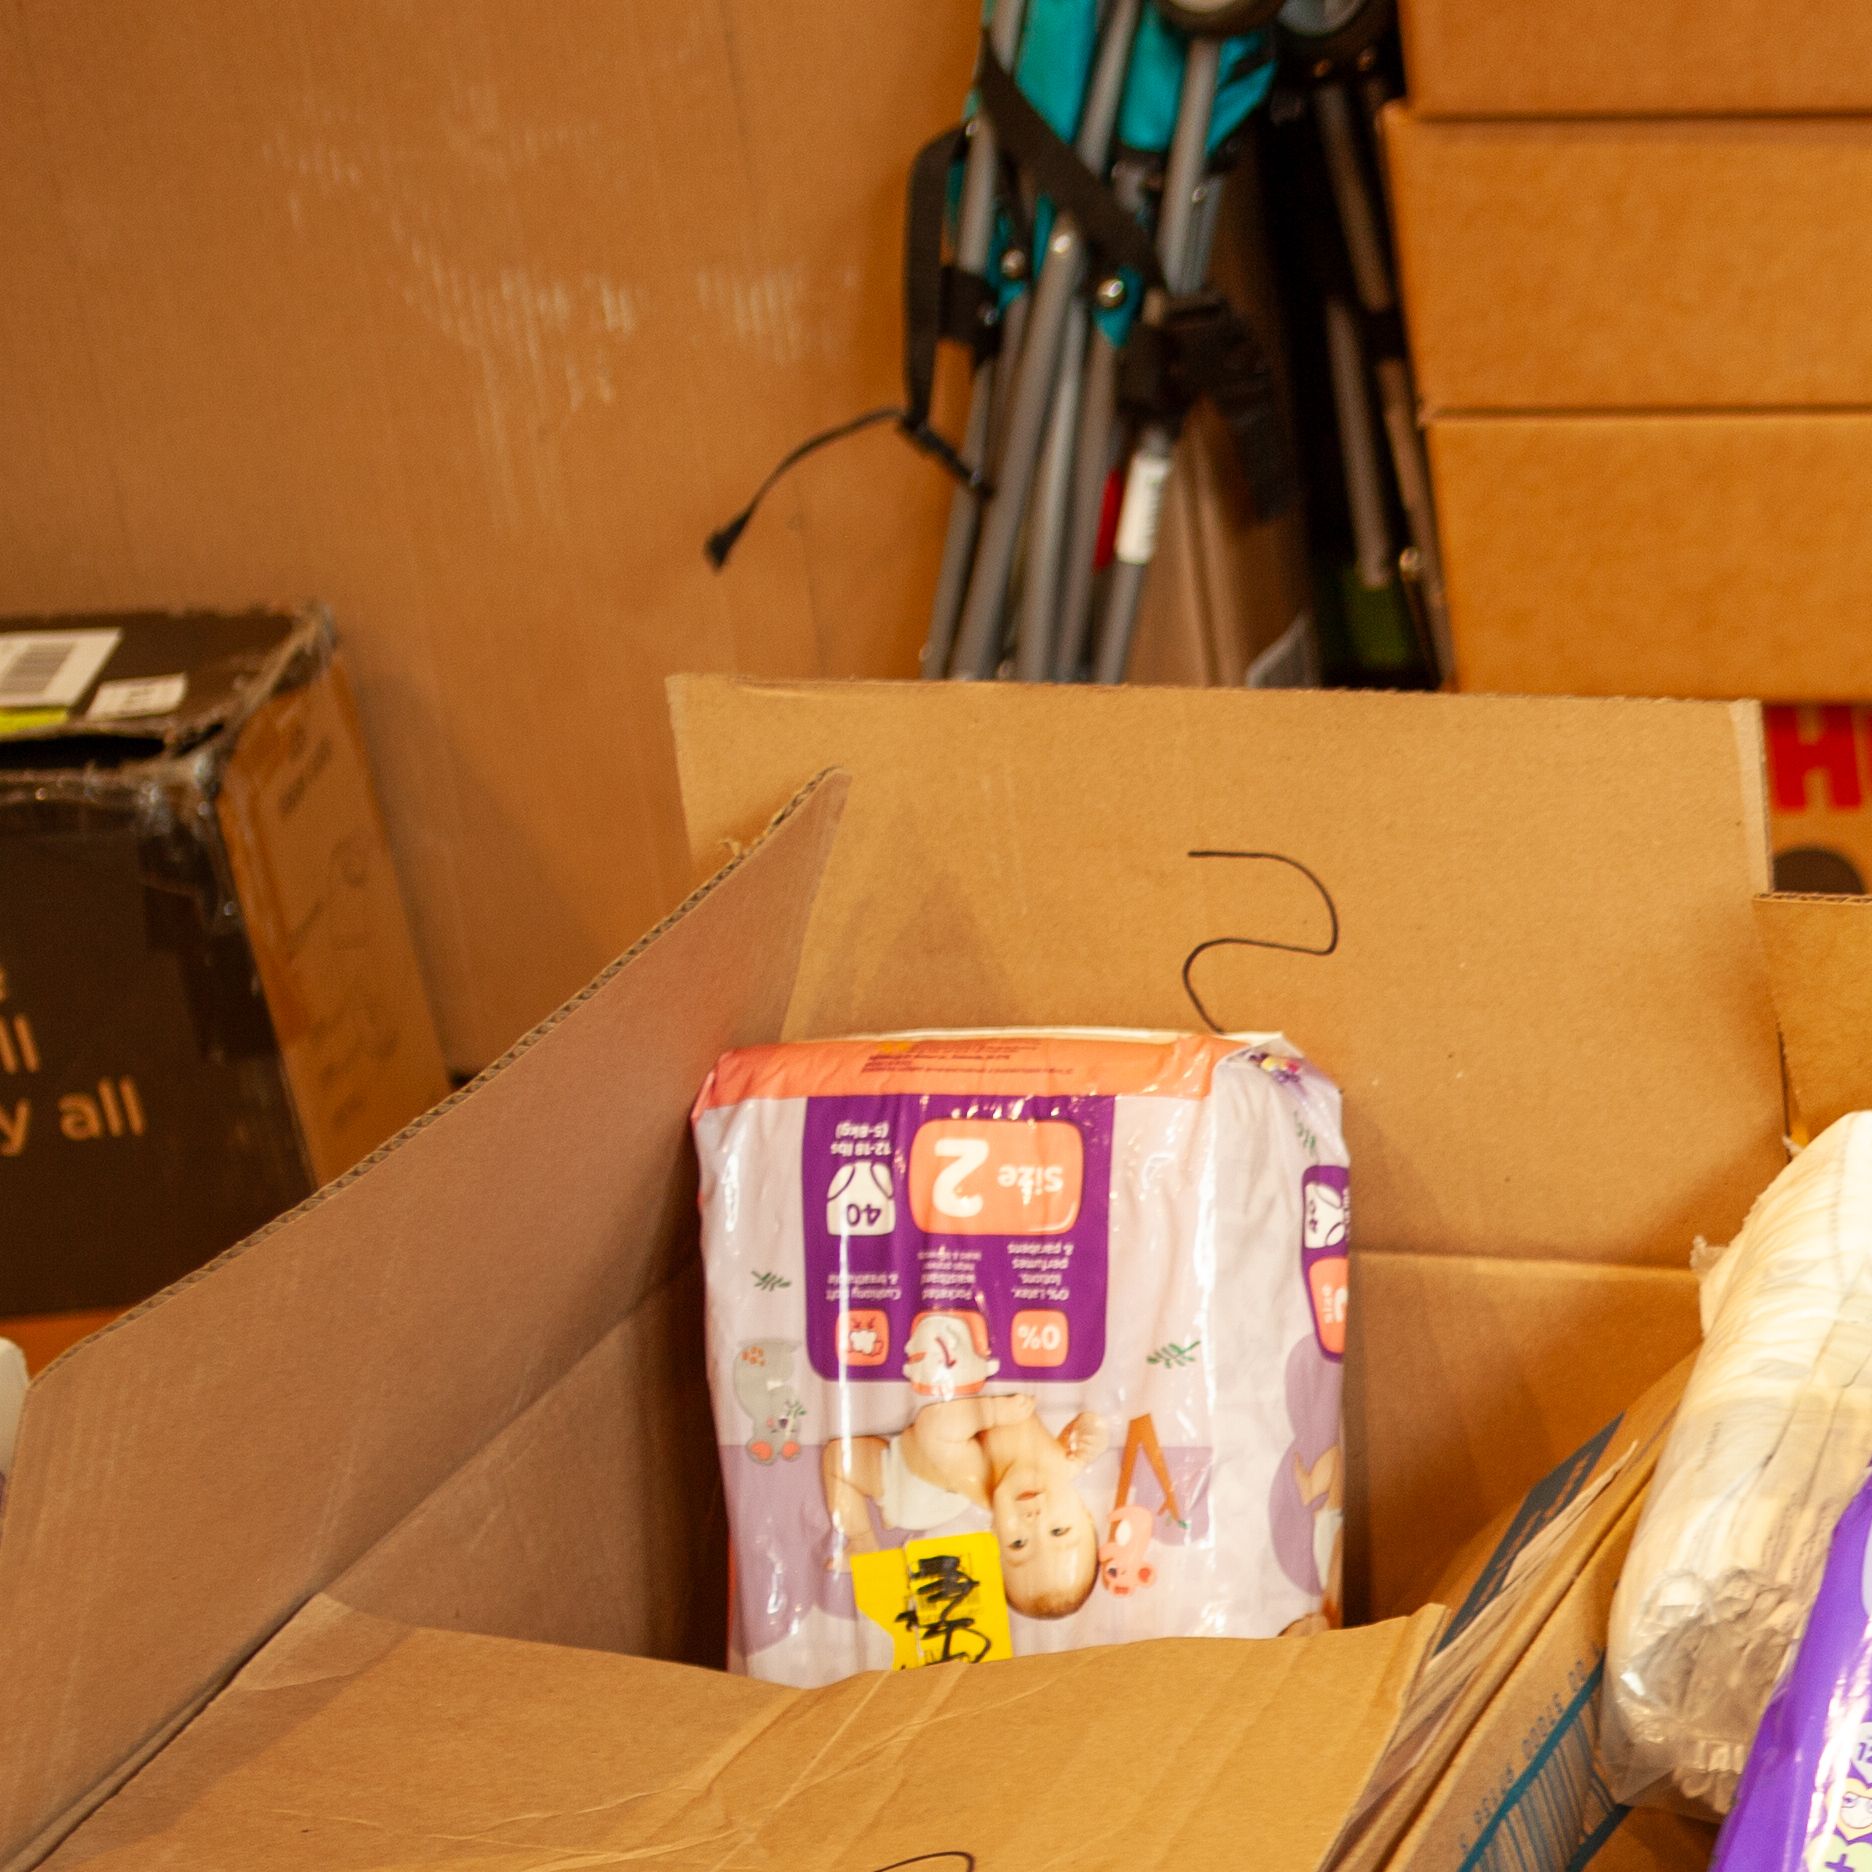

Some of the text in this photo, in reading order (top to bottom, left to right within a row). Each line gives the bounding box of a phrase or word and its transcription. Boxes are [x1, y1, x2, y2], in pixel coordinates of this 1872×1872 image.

[57, 1073, 146, 1143] all
[933, 1138, 1064, 1219] 2 Size
[1018, 1325, 1061, 1352] 0%
